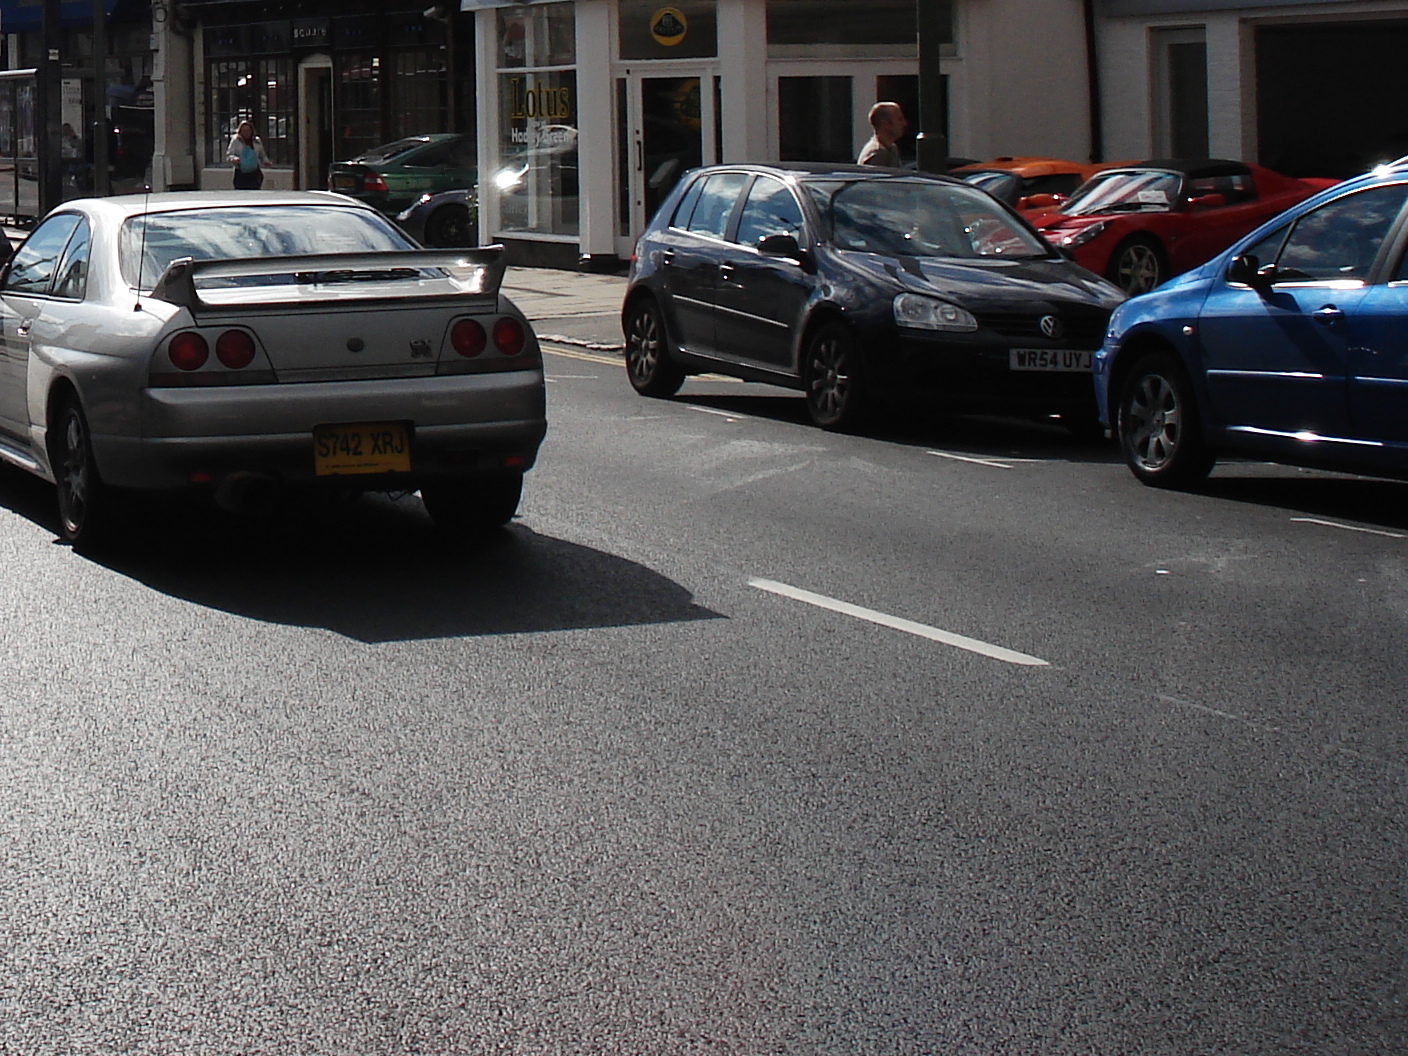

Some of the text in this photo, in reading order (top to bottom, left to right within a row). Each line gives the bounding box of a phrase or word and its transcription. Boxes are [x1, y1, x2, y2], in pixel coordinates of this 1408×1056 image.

[510, 78, 570, 119] Lotus
[1016, 350, 1092, 369] WR54 UYJ
[317, 431, 404, 458] S742 XRJ
